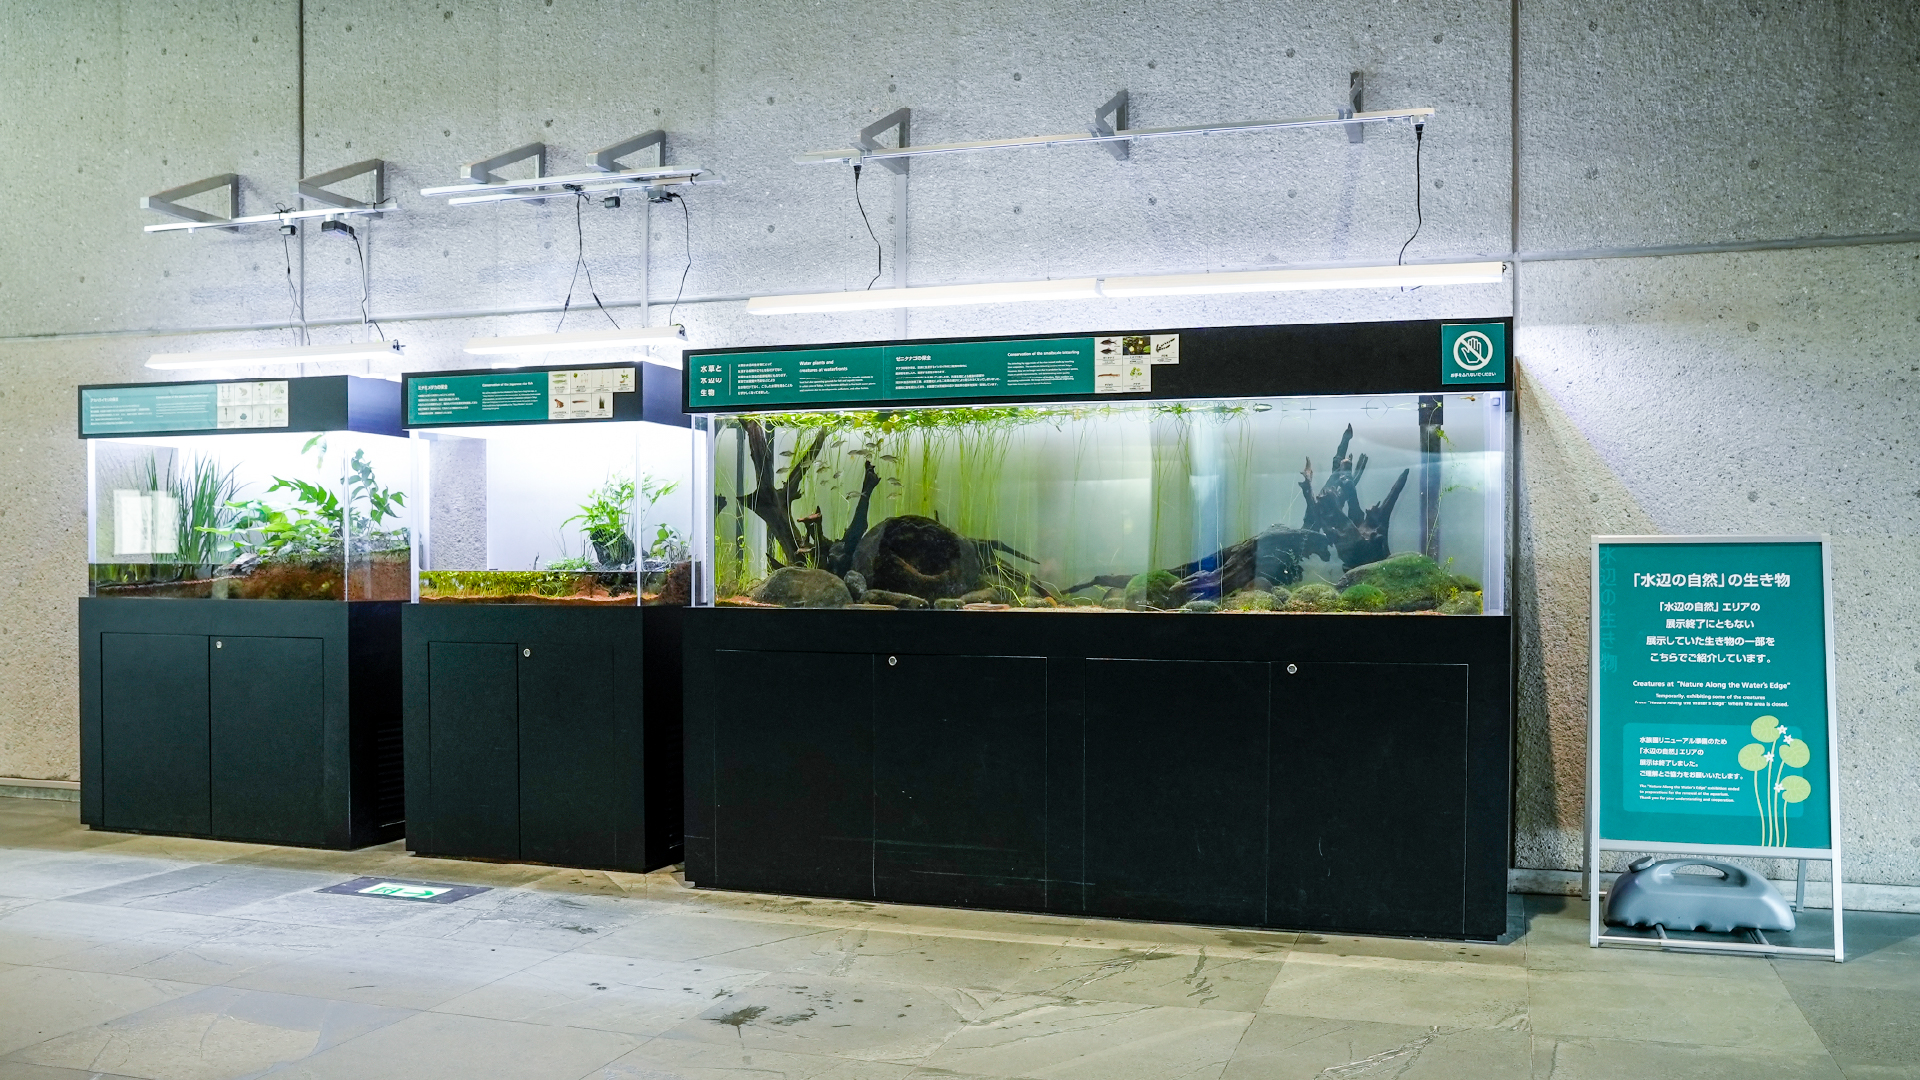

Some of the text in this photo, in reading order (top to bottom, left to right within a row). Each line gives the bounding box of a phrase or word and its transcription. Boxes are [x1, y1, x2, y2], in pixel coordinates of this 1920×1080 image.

[700, 365, 722, 373] 水草と
[1634, 573, 1790, 588] 「水辺の自然」の生き物
[1666, 619, 1754, 629] 展示終了にともない
[1646, 636, 1775, 647] 展示していた生き物の一部を
[1650, 653, 1771, 664] こちらでご紹介しています。
[1640, 759, 1698, 767] 展示は終了しました。
[1640, 771, 1743, 780] ご理解とご協力をお願いいたします。
